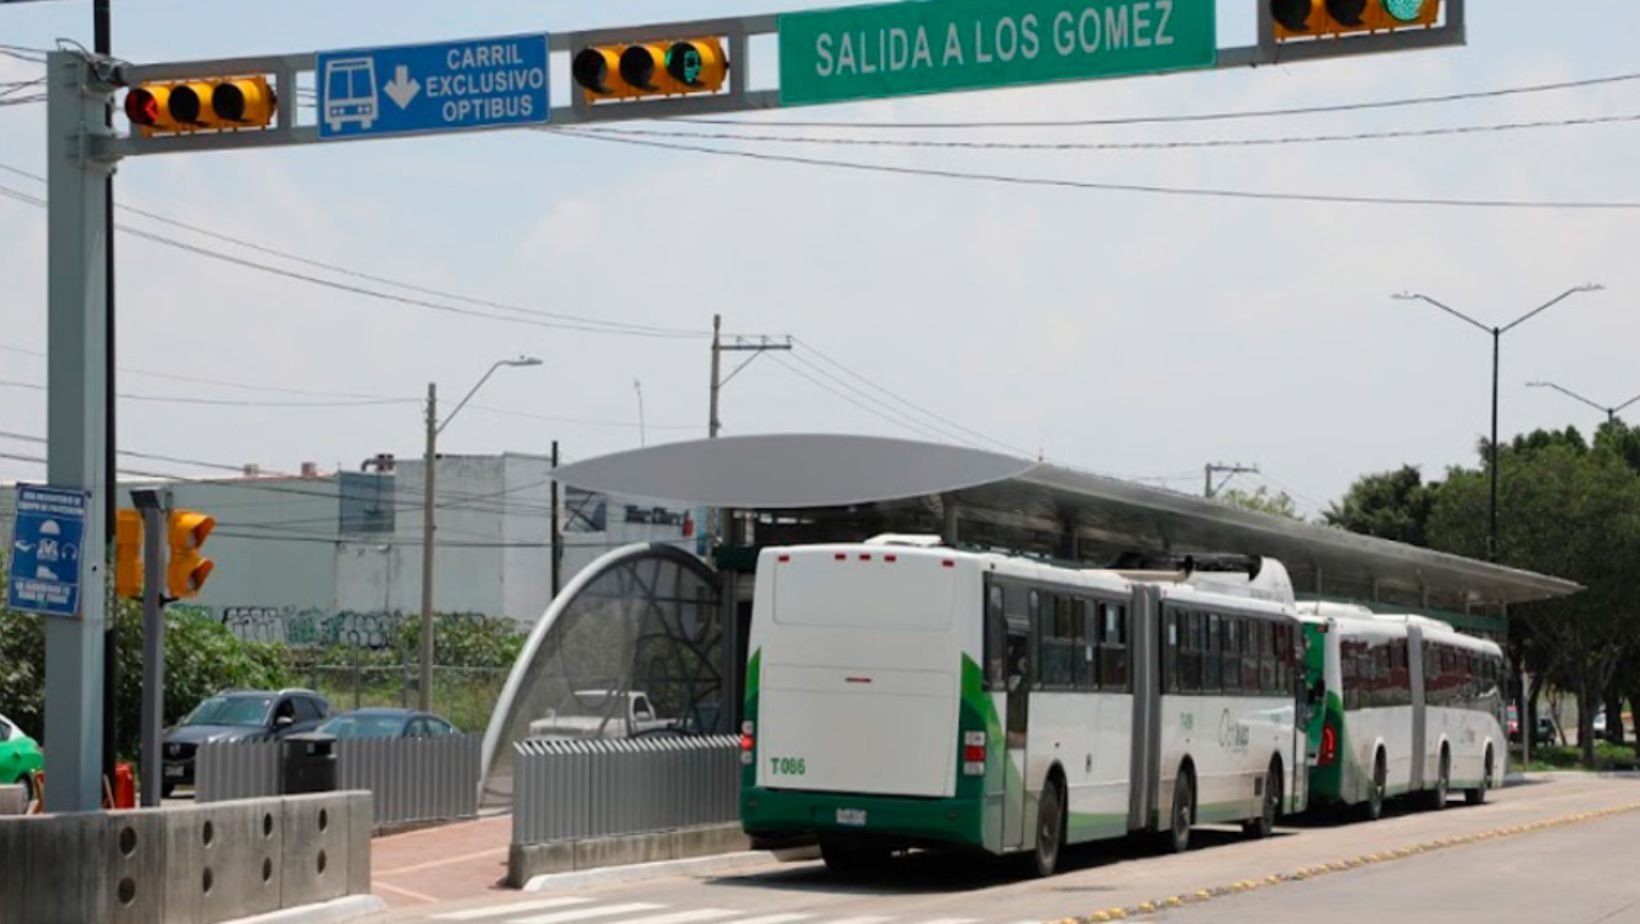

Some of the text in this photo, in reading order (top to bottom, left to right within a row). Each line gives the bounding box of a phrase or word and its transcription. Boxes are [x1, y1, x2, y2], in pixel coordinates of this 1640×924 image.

[815, 1, 1174, 77] SALIDA A LOS GOMEZ
[446, 43, 524, 70] CARRIL
[425, 67, 544, 97] EXCLUSIVO
[442, 94, 533, 122] OPTIBUS
